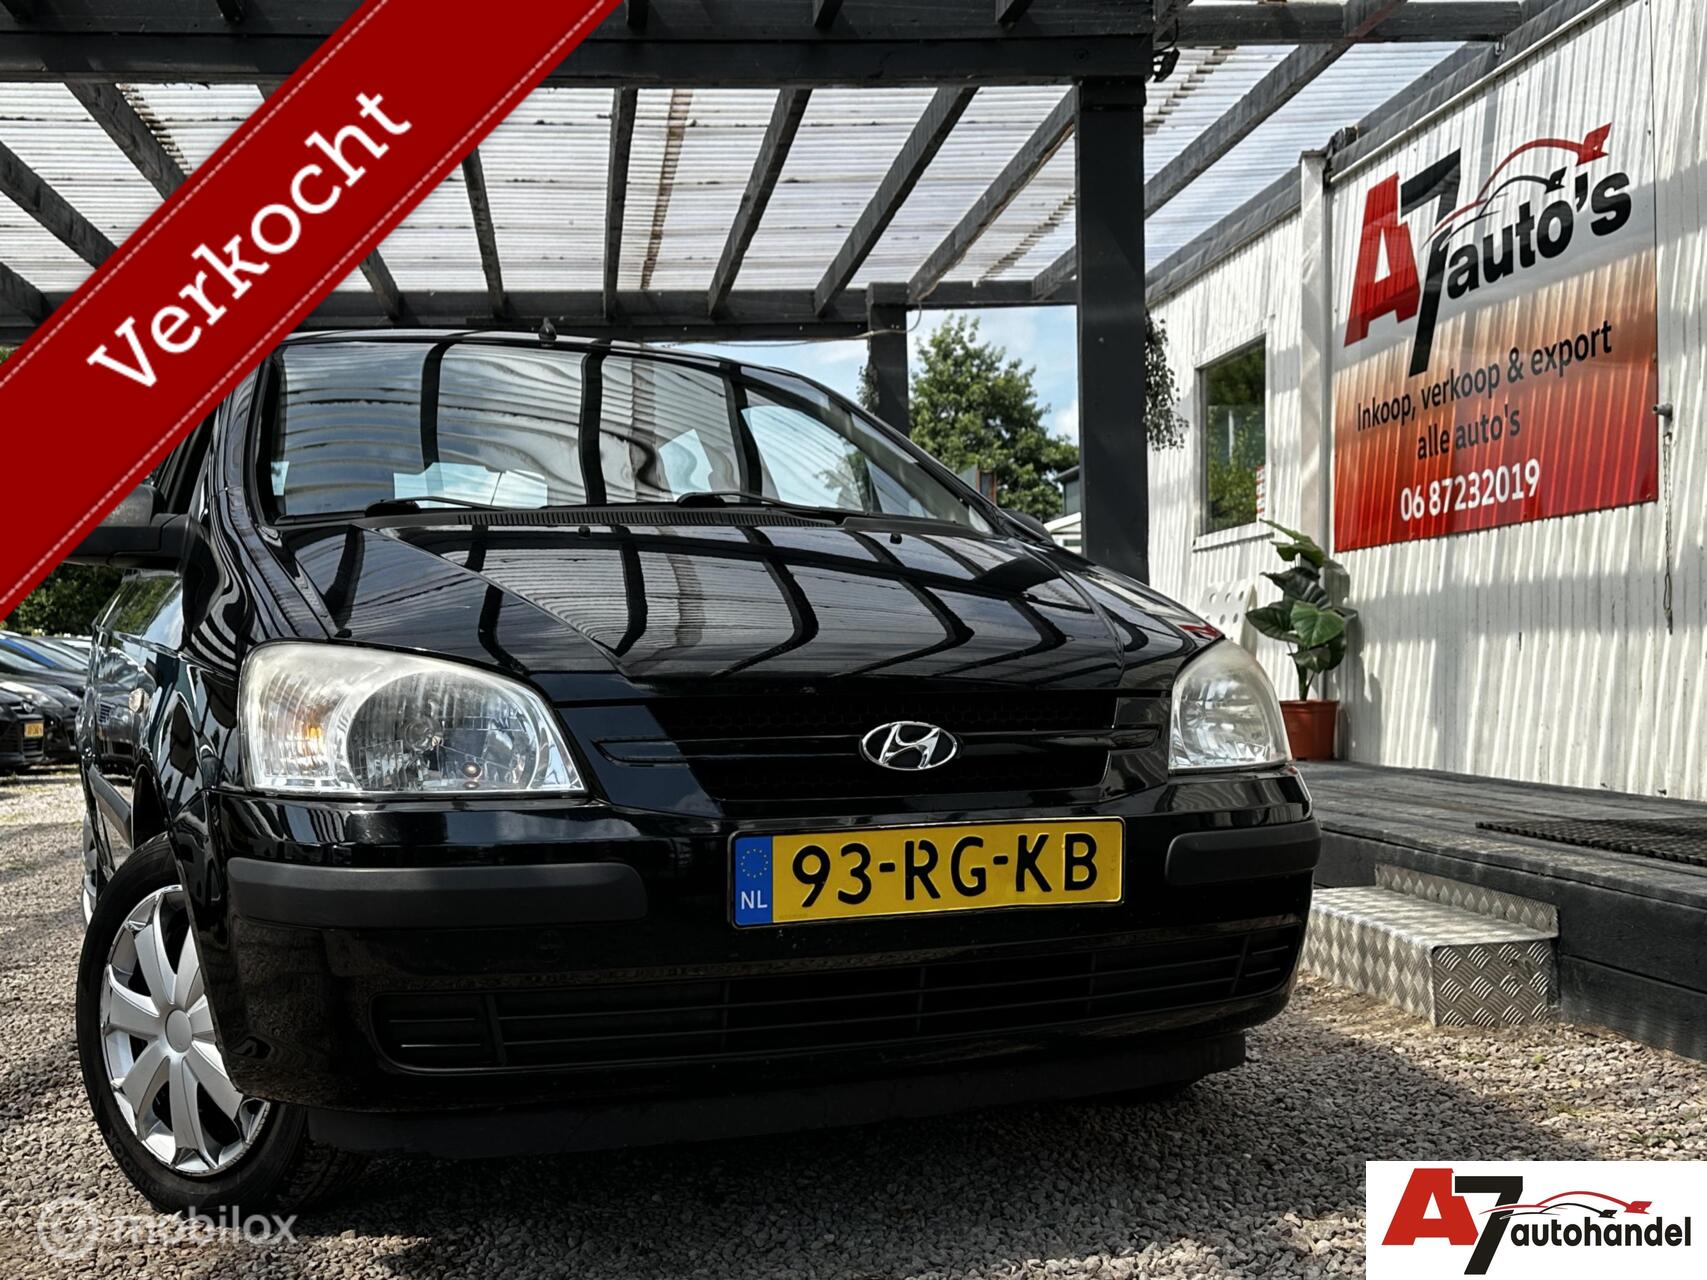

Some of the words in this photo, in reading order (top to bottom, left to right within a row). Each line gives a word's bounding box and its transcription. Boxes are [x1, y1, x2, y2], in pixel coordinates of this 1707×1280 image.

[1344, 147, 1462, 378] A7
[1446, 171, 1633, 300] auto's
[1357, 392, 1417, 432] Inkoop,
[1420, 361, 1501, 410] verkoop
[1507, 347, 1524, 384] &
[1531, 320, 1613, 376] export
[1417, 423, 1450, 461] alle
[1454, 402, 1522, 451] auto's
[1400, 485, 1425, 522] 06
[1428, 458, 1540, 518] 87232019
[740, 890, 768, 910] NL
[792, 831, 1098, 908] 93-RG-KB
